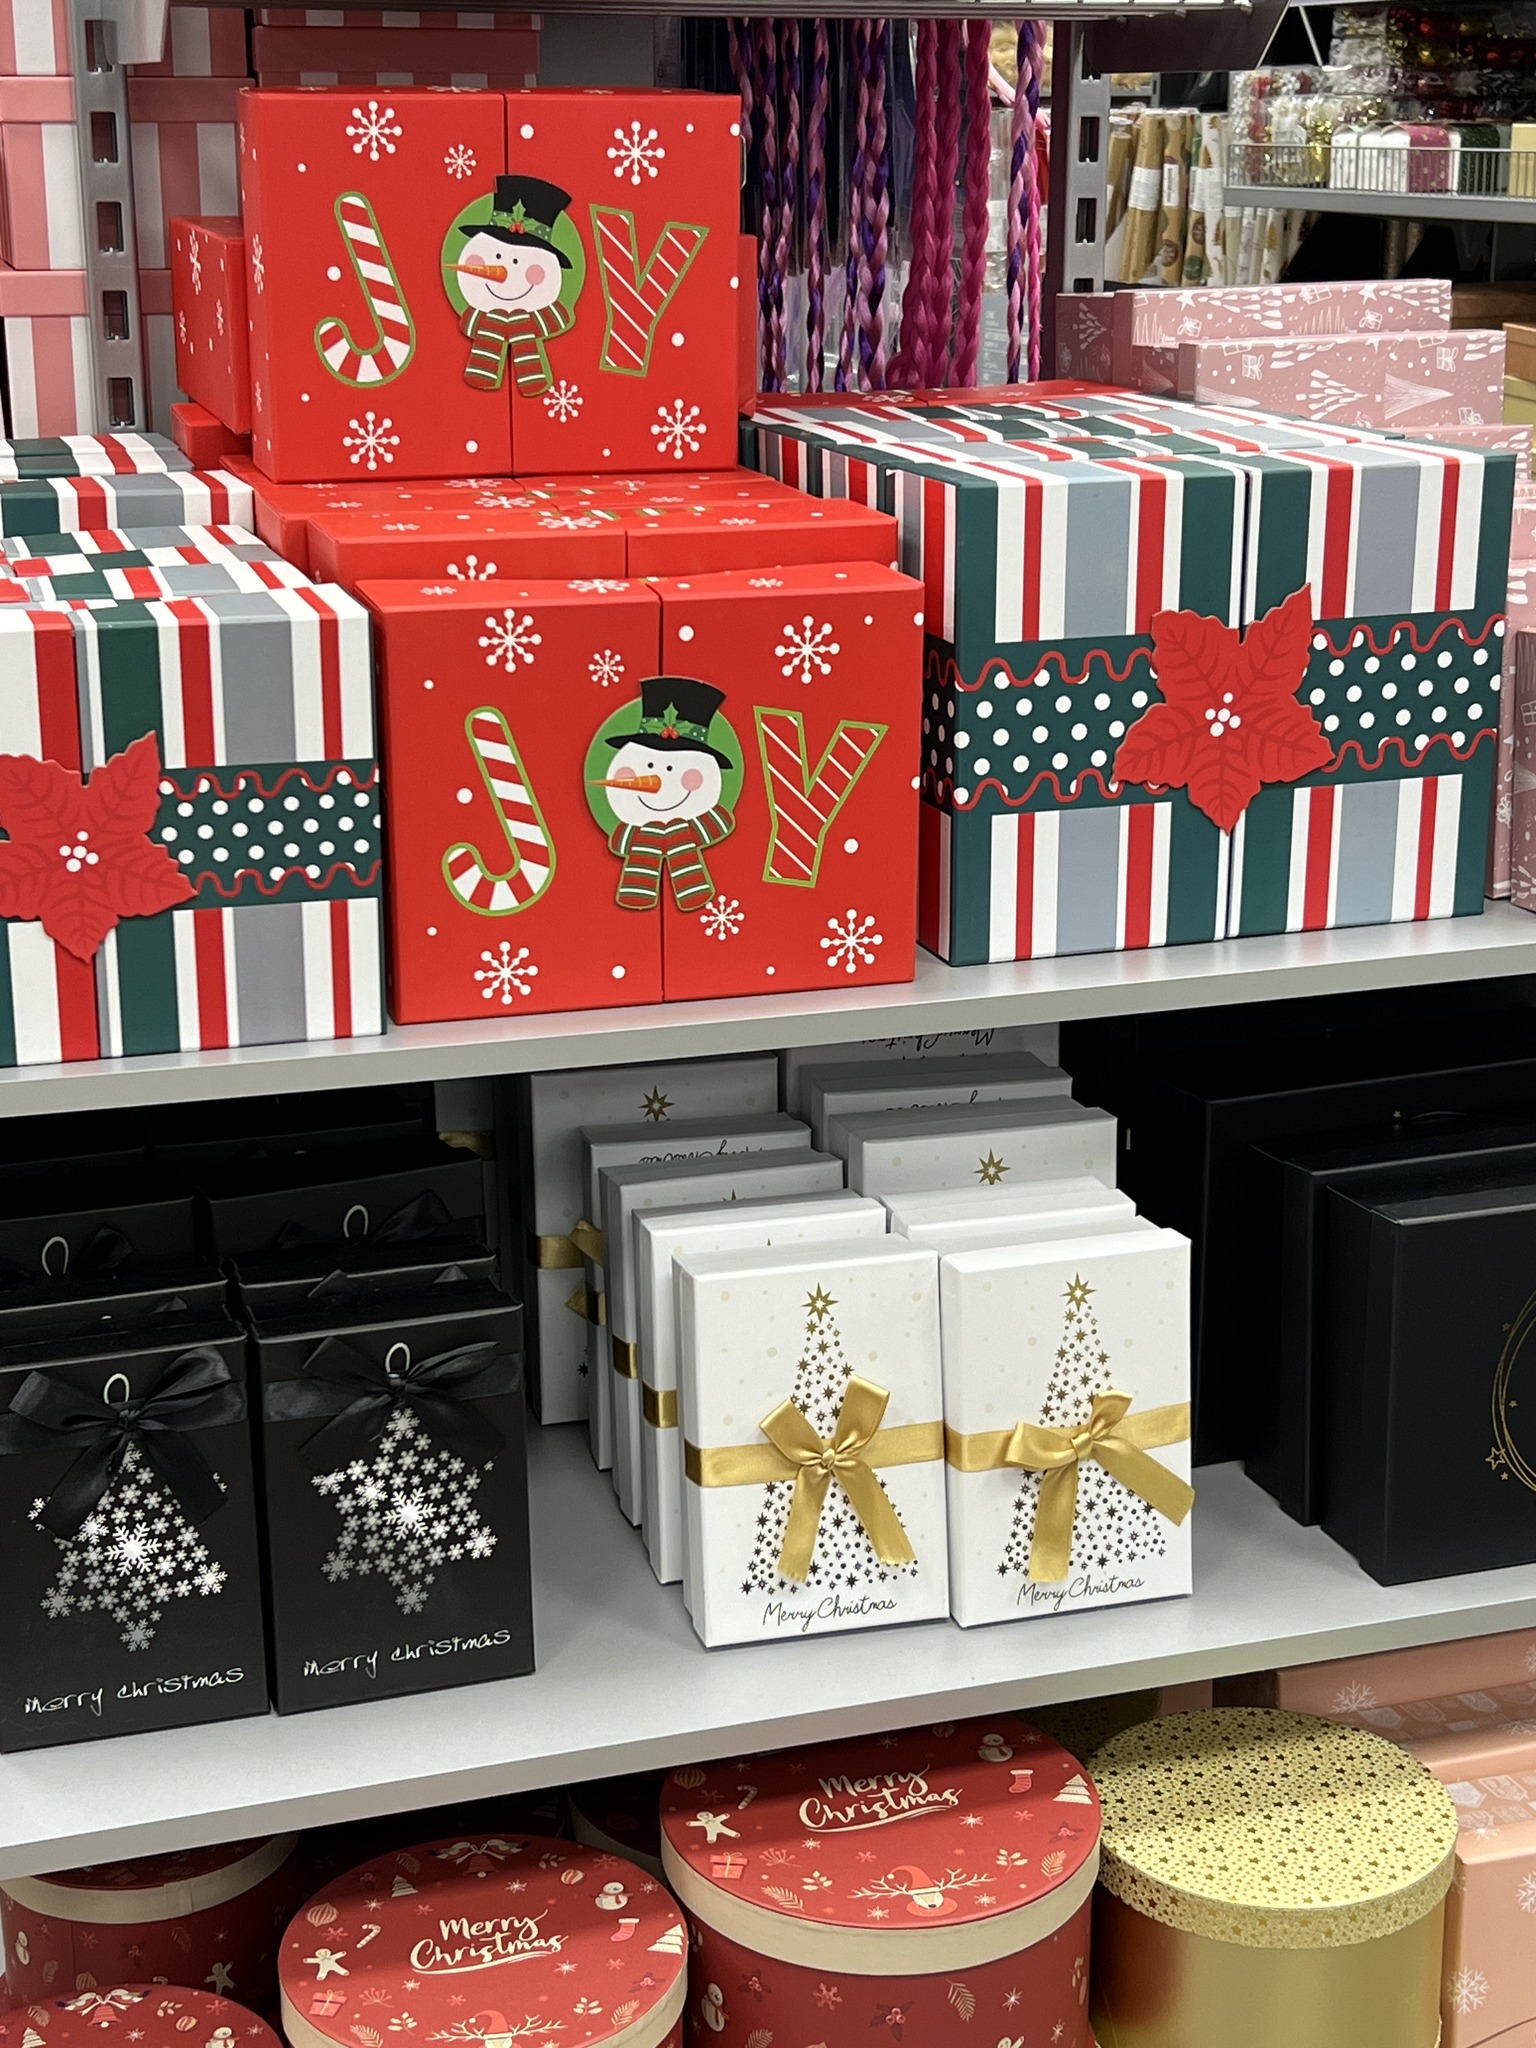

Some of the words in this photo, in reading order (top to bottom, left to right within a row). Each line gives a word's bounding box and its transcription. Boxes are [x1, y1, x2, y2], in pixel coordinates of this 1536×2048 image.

[1017, 1582, 1068, 1611] Merry
[1067, 1574, 1146, 1598] Christmas
[763, 1602, 817, 1632] Merry
[816, 1594, 898, 1619] Christmas
[818, 1763, 931, 1798] Merry
[799, 1788, 963, 1828] Christmas
[439, 1909, 549, 1942] Merry
[410, 1931, 569, 1970] Christmas
